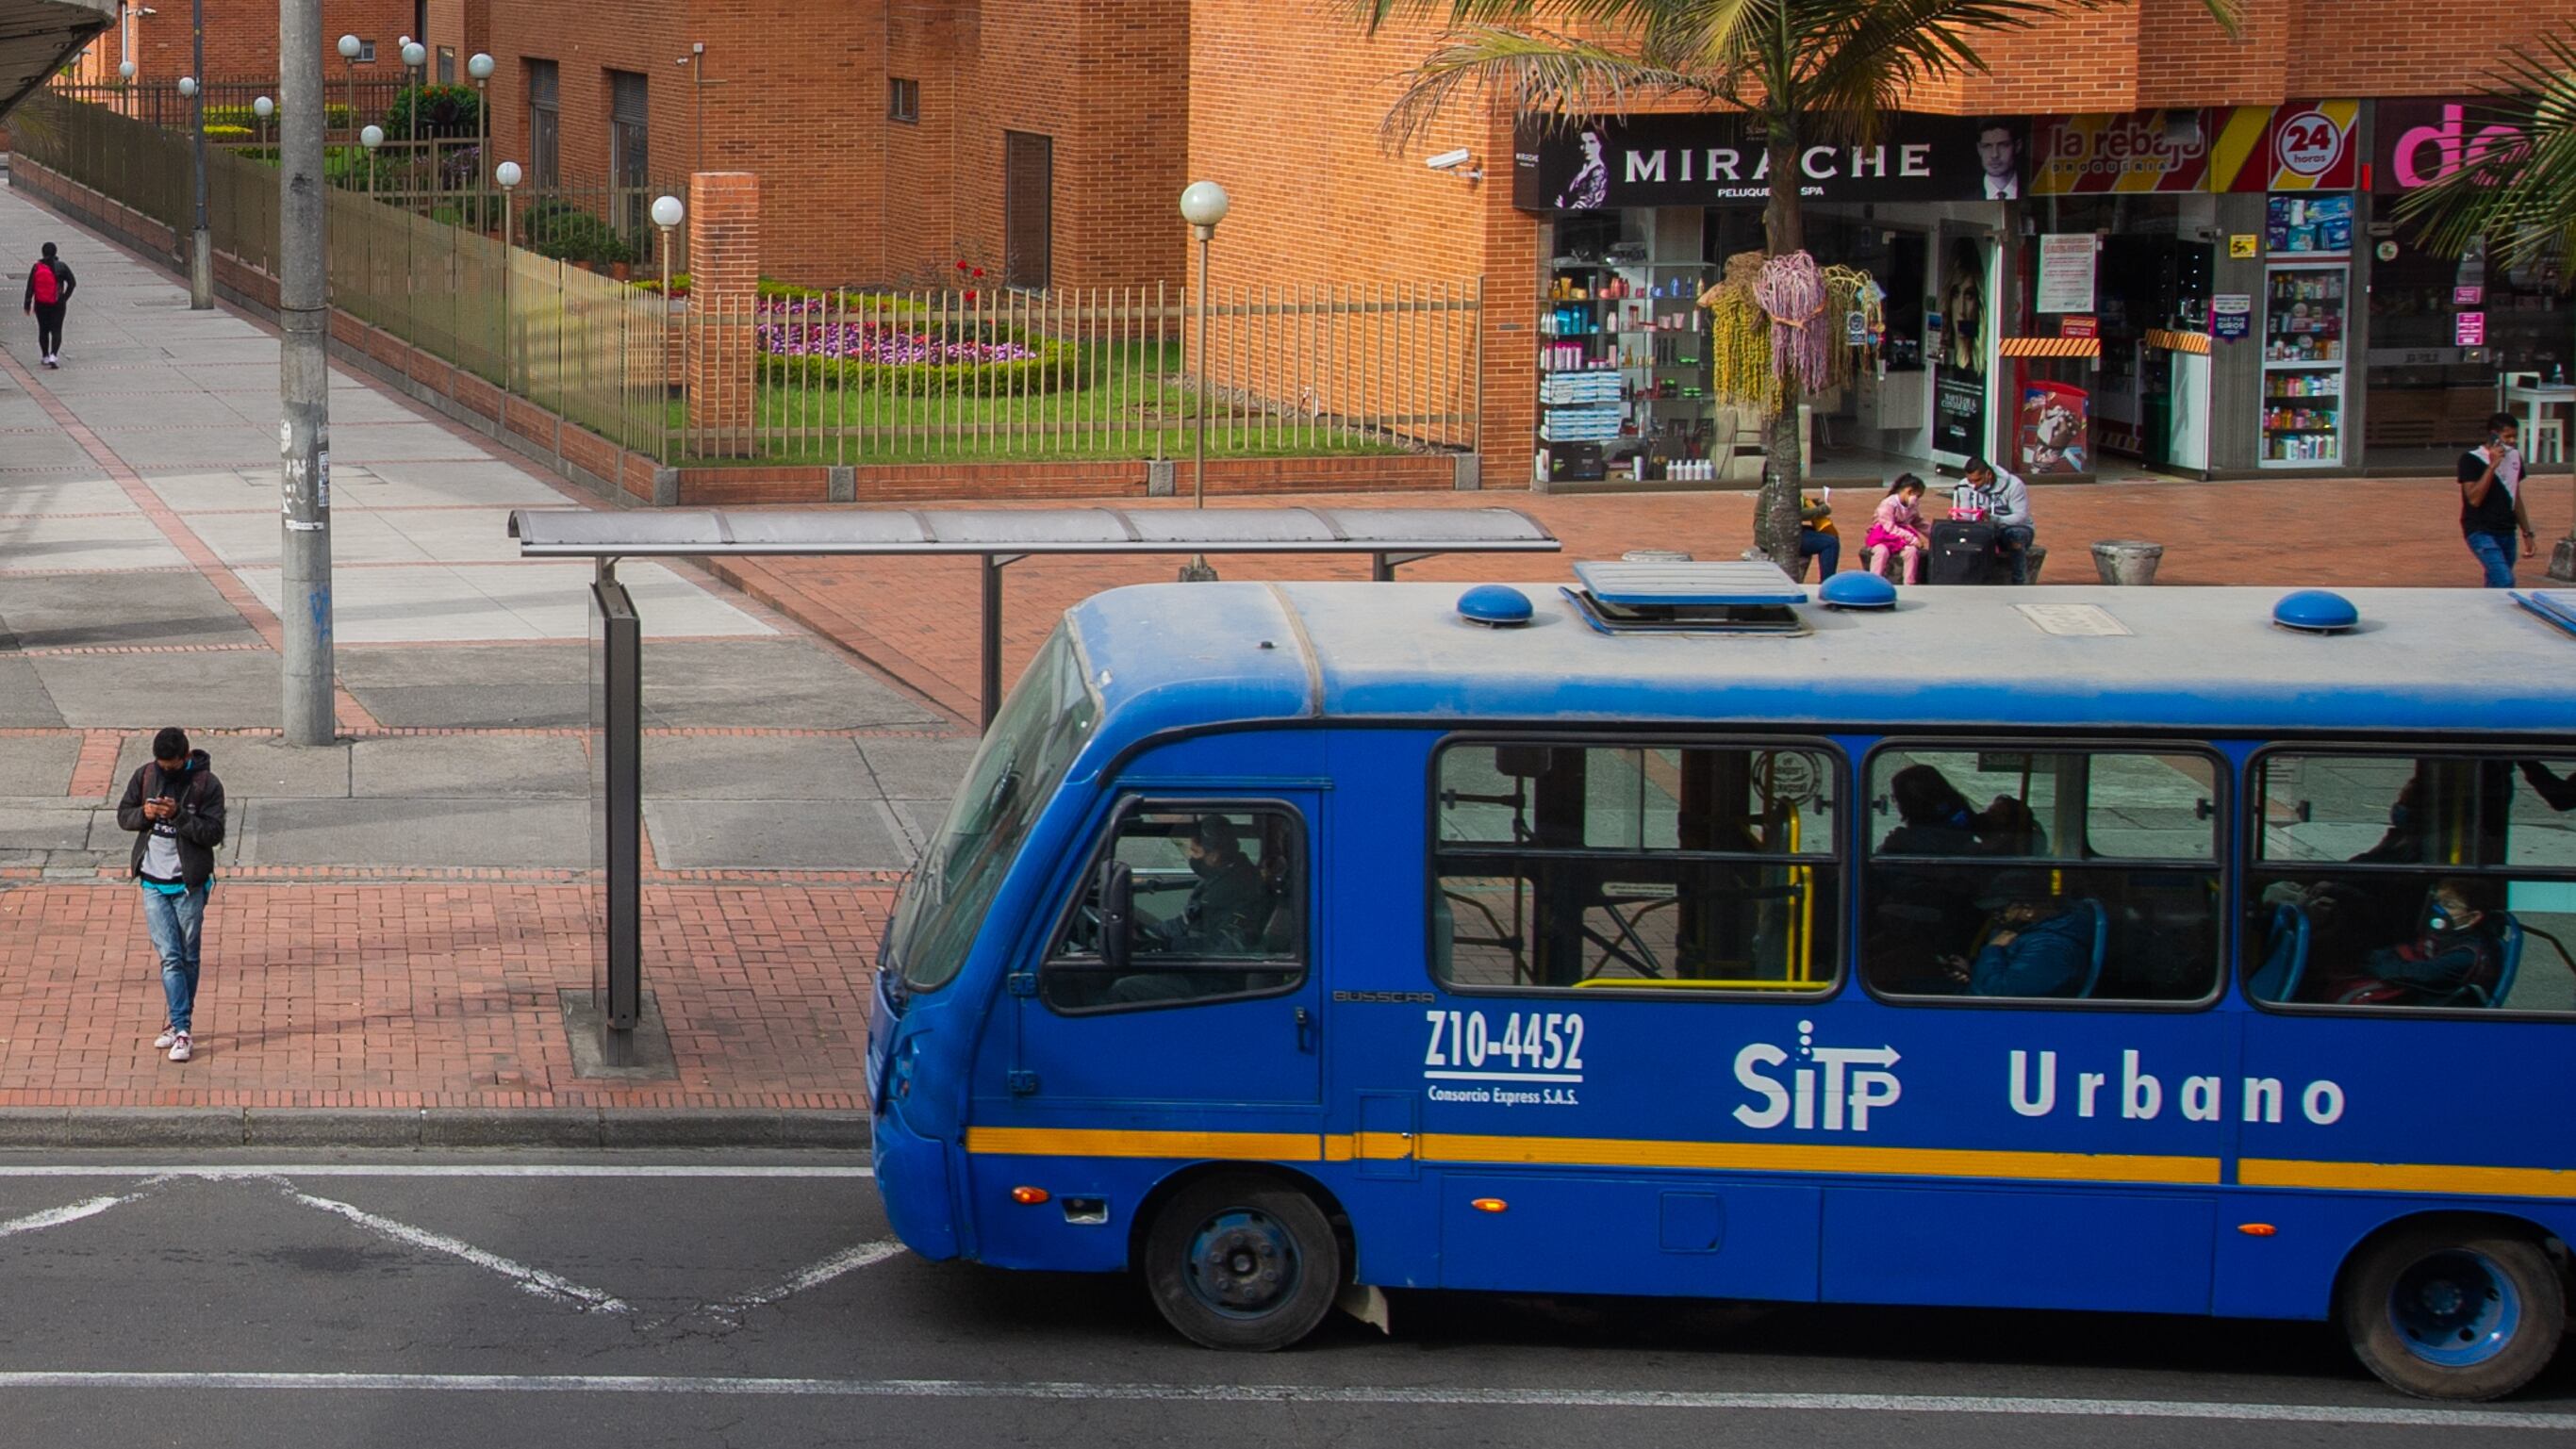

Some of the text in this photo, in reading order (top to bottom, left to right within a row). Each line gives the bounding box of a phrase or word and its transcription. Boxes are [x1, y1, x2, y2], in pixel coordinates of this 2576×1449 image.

[2052, 123, 2085, 158] la
[2287, 123, 2331, 152] 24
[2293, 155, 2326, 163] horas
[1800, 186, 1825, 196] SPA
[1332, 990, 1435, 1003] BUSSCAR
[1425, 1010, 1585, 1070] Z10-4452
[1428, 1085, 1579, 1106] Consorcio Express S.A.S.
[2008, 1049, 2345, 1126] Urbano
